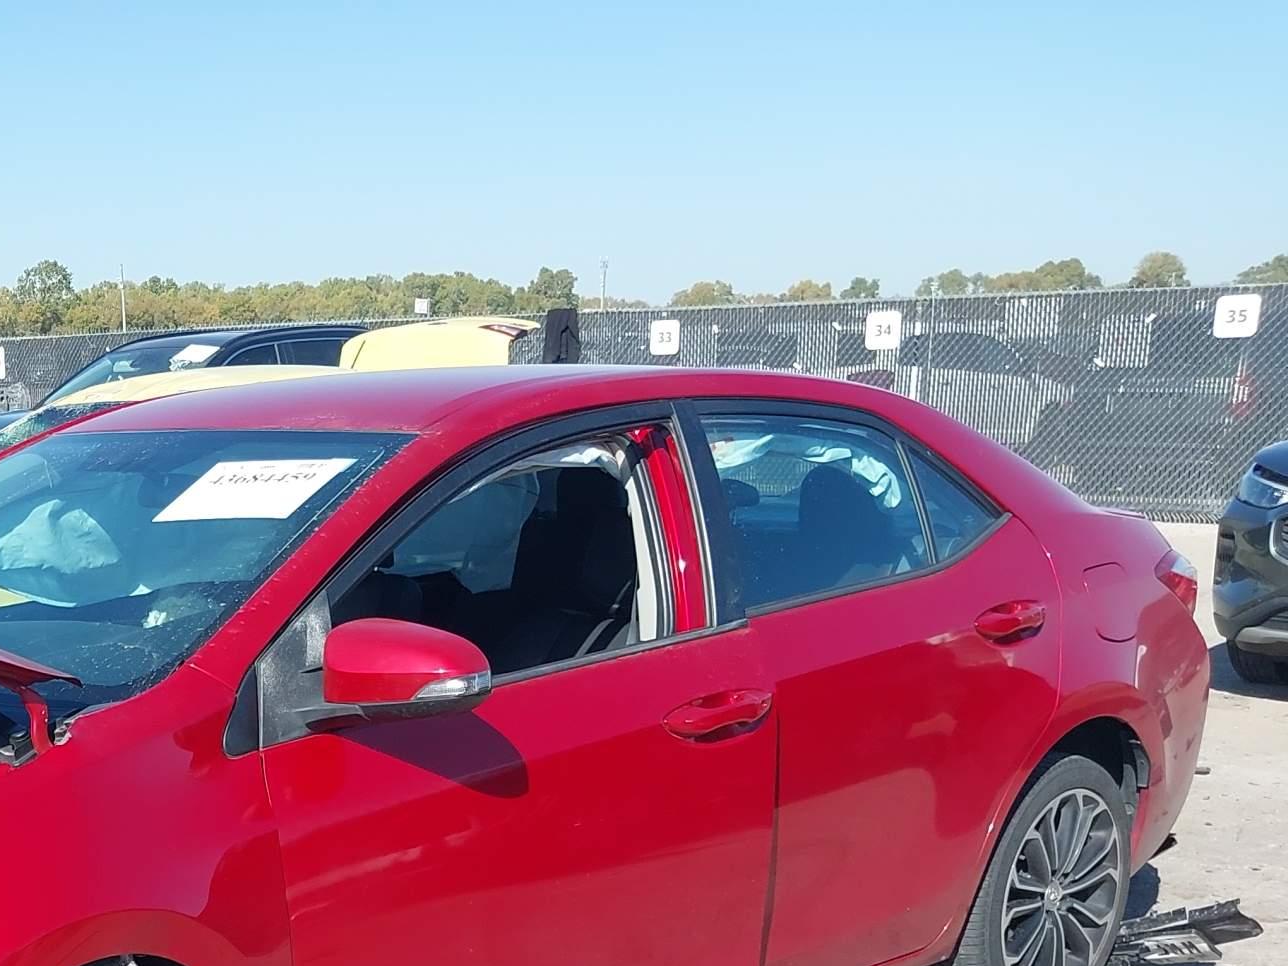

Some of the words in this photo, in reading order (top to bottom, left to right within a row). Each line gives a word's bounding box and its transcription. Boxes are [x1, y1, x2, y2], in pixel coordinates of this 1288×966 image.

[1225, 309, 1248, 323] 35
[658, 331, 672, 343] 33
[874, 324, 892, 337] 34
